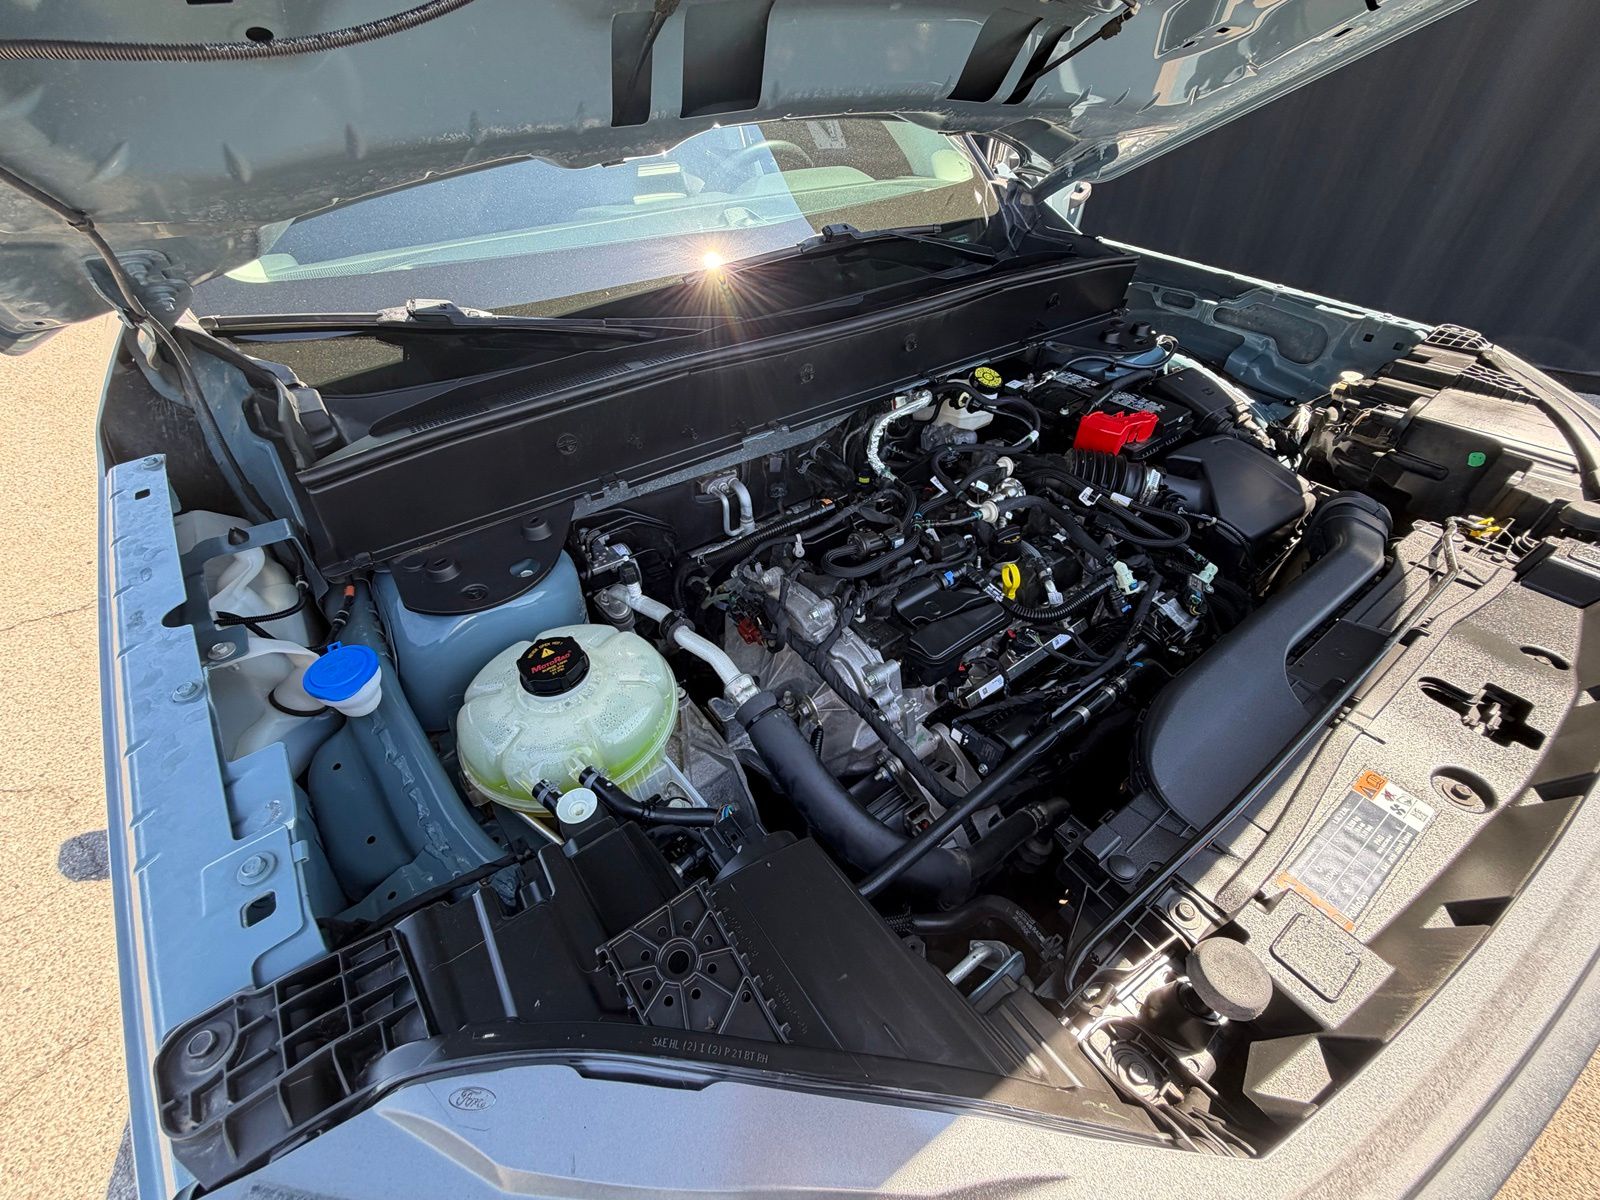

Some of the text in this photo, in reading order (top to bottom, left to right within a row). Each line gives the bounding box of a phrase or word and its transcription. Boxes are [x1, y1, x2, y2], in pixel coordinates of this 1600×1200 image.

[652, 1036, 668, 1048] SAE
[682, 1040, 697, 1052] (2)
[707, 1043, 722, 1056] (2)
[455, 1088, 489, 1109] Ford
